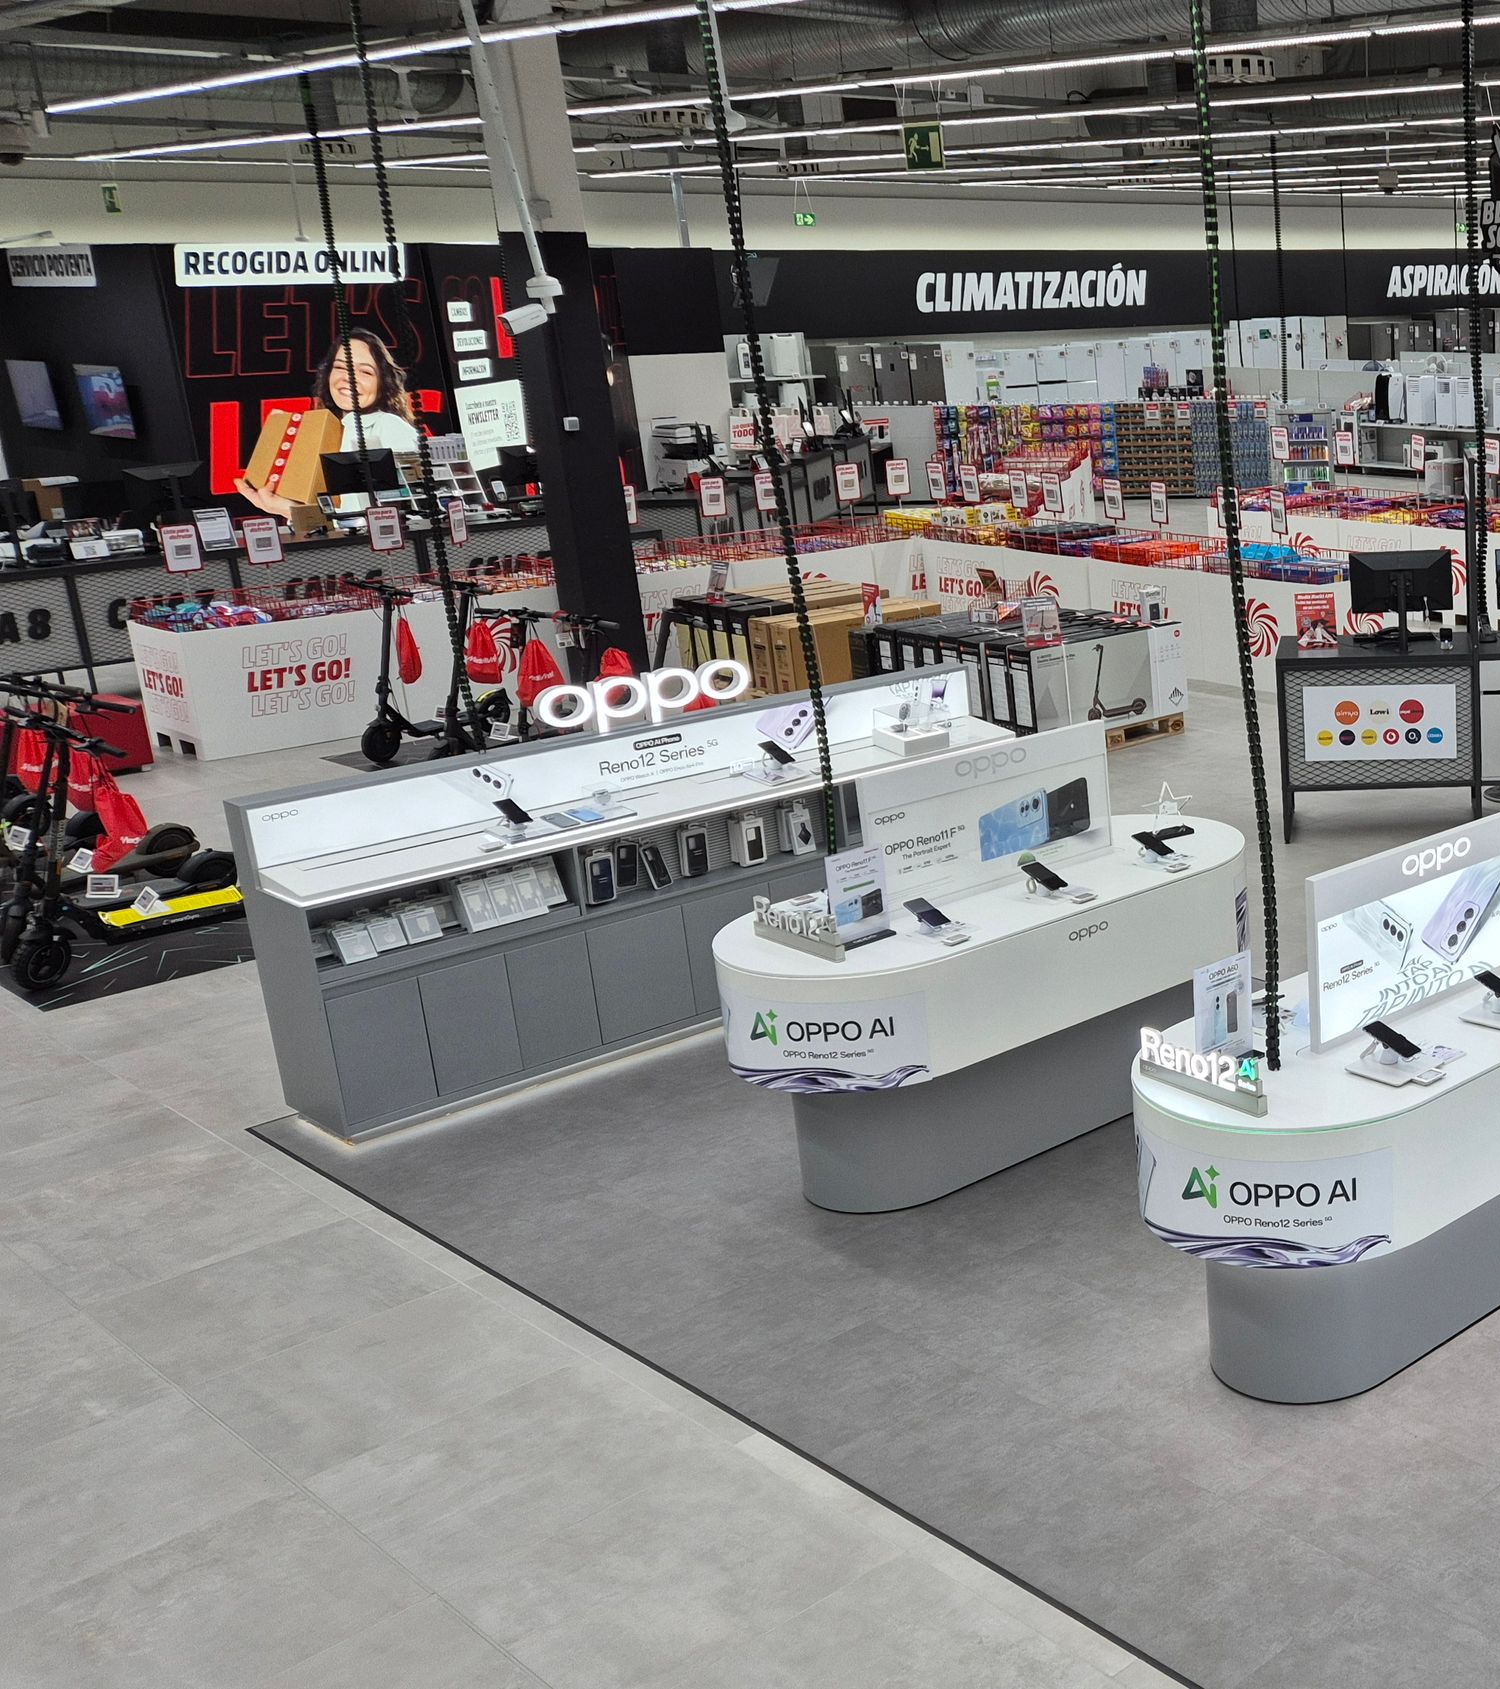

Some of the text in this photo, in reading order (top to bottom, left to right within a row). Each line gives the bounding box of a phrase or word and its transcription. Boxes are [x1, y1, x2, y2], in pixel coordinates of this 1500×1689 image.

[10, 253, 93, 277] SERVICIO POSVENTA
[184, 251, 308, 276] RECOGIDA
[916, 262, 1147, 314] CLIMATIZACIÓN
[468, 408, 499, 425] NEWSLETTER
[939, 576, 986, 598] LET'S GO
[241, 633, 348, 670] LET'S GO!
[142, 669, 184, 699] LET'S GO!
[247, 657, 351, 694] LET'S GO!
[251, 681, 356, 718] LET'S GO!
[535, 658, 749, 735] oppo
[1370, 708, 1390, 716] Lowi
[599, 738, 718, 777] Reno12 Series 5G
[954, 746, 1027, 780] oppo
[261, 808, 299, 824] oppo
[874, 810, 906, 826] oppo
[884, 838, 915, 856] OPPO
[916, 828, 950, 847] Reno11
[950, 826, 957, 839] F
[902, 842, 952, 861] The Portrait Expert
[1401, 835, 1472, 877] oppo
[753, 894, 820, 943] Reno12
[1068, 920, 1109, 943] oppo
[1208, 967, 1227, 981] OPPO
[1322, 973, 1350, 993] Reno12
[1351, 966, 1374, 982] Series
[786, 1020, 863, 1043] OPPO
[868, 1016, 895, 1040] AI
[783, 1049, 807, 1060] OPPO
[808, 1051, 838, 1060] Reno12
[840, 1049, 866, 1059] Series
[1140, 1026, 1237, 1093] Reno12
[1229, 1181, 1320, 1209] OPPO
[1328, 1177, 1357, 1206] AI
[1223, 1214, 1252, 1227] OPPO
[1254, 1216, 1290, 1229] Reno12
[1292, 1215, 1323, 1229] Series
